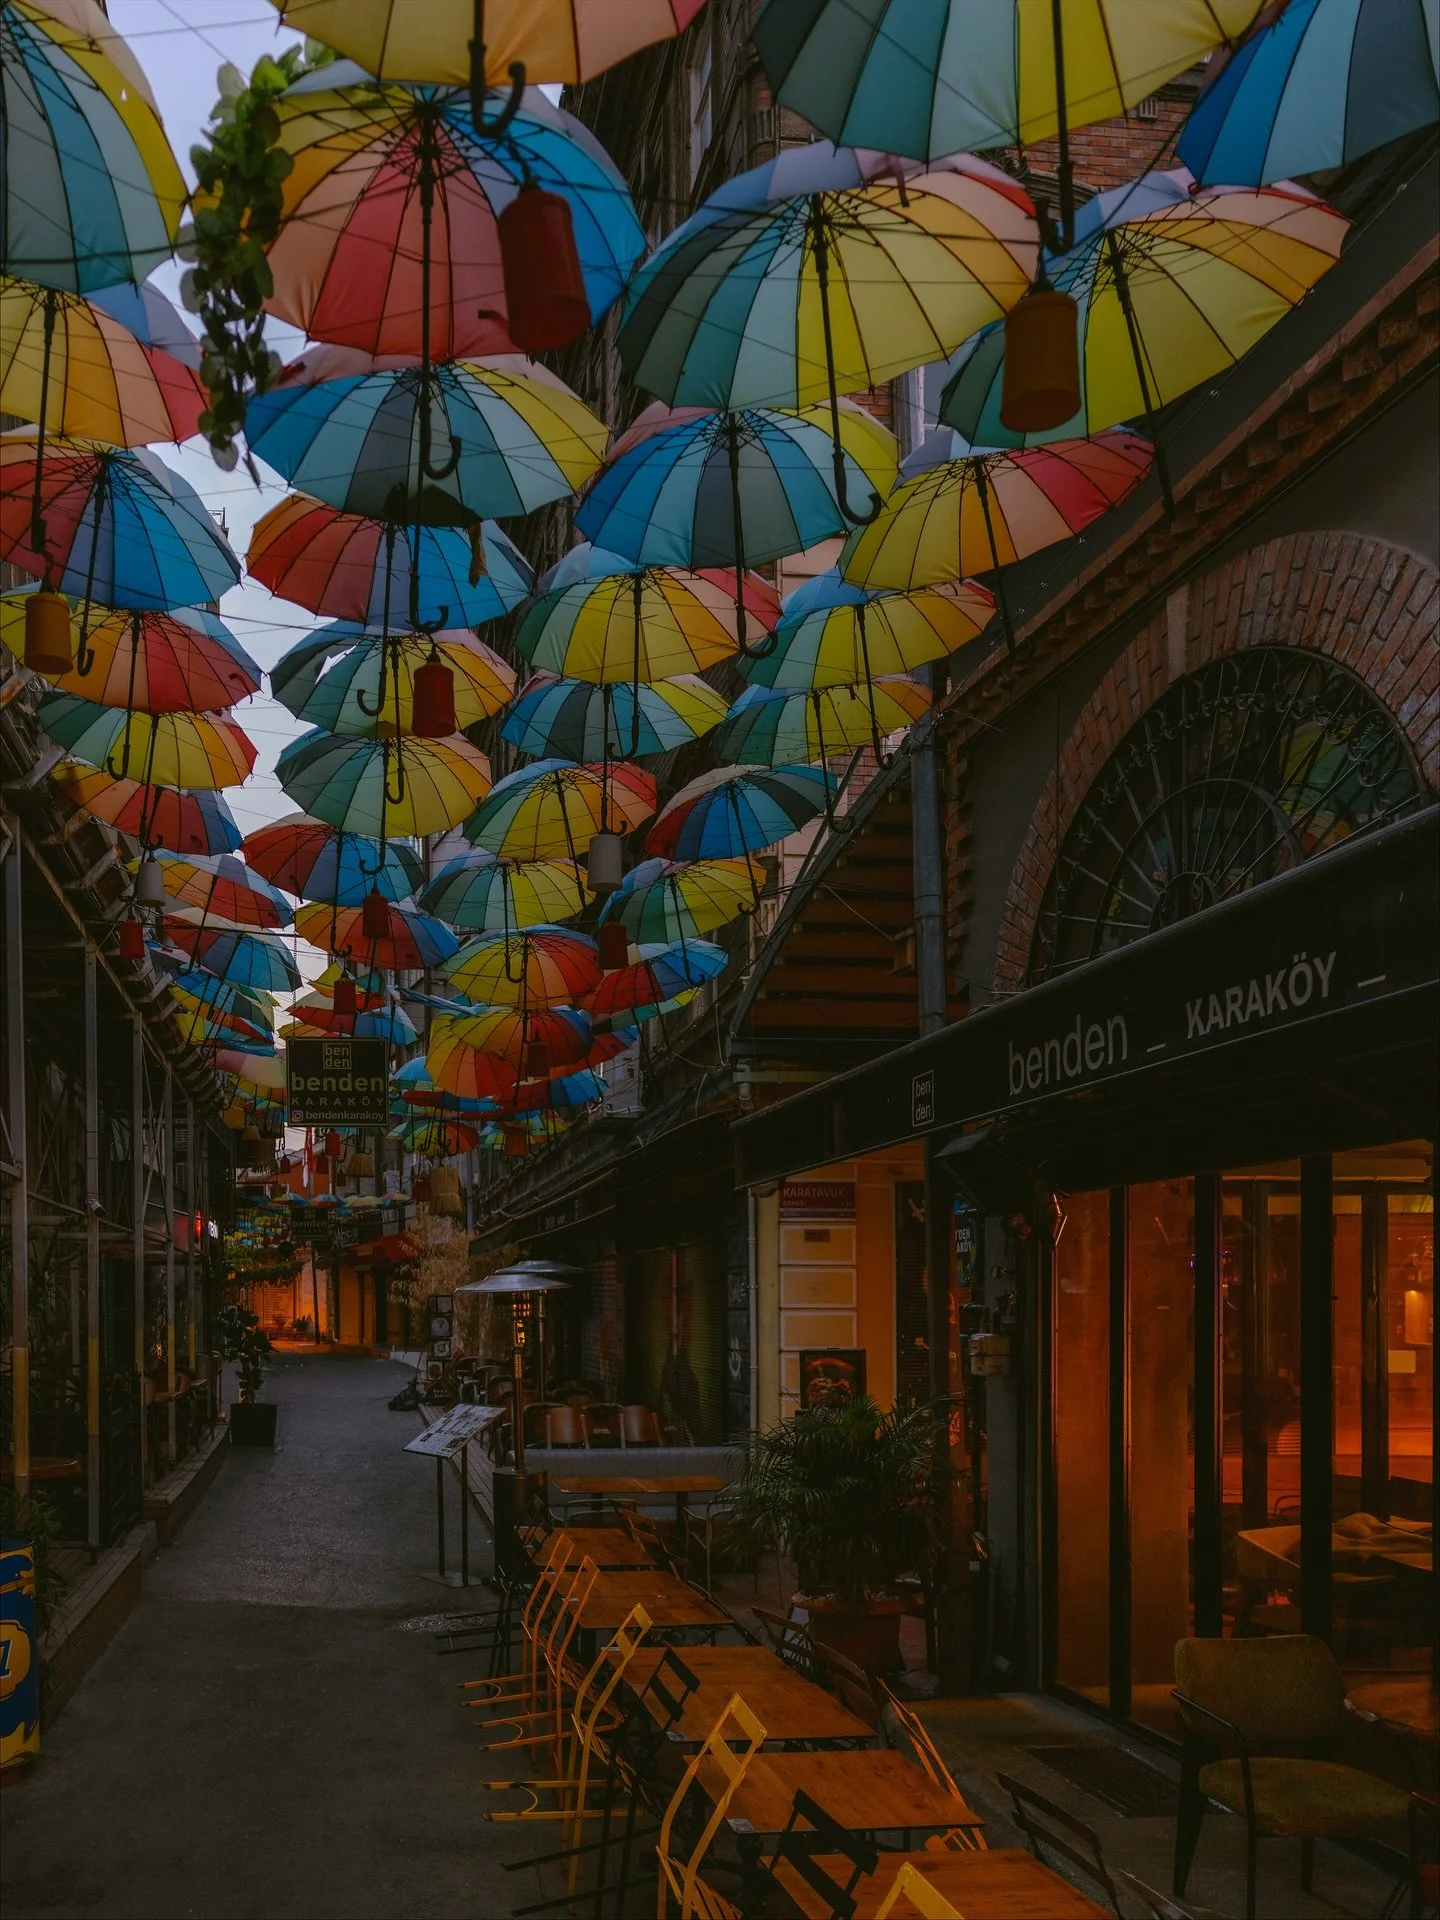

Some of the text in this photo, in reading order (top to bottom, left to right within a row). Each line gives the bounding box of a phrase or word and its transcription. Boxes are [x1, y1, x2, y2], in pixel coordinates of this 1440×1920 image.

[1008, 951, 1337, 1096] benden KARAKÖY
[325, 1043, 350, 1056] ben
[325, 1056, 350, 1068] den
[291, 1072, 384, 1091] benden
[915, 1080, 931, 1097] ben
[291, 1096, 384, 1106] KARAKÖY
[305, 1110, 384, 1122] bendenkarakoy
[915, 1103, 931, 1121] den
[783, 1186, 846, 1199] KARATAVUK
